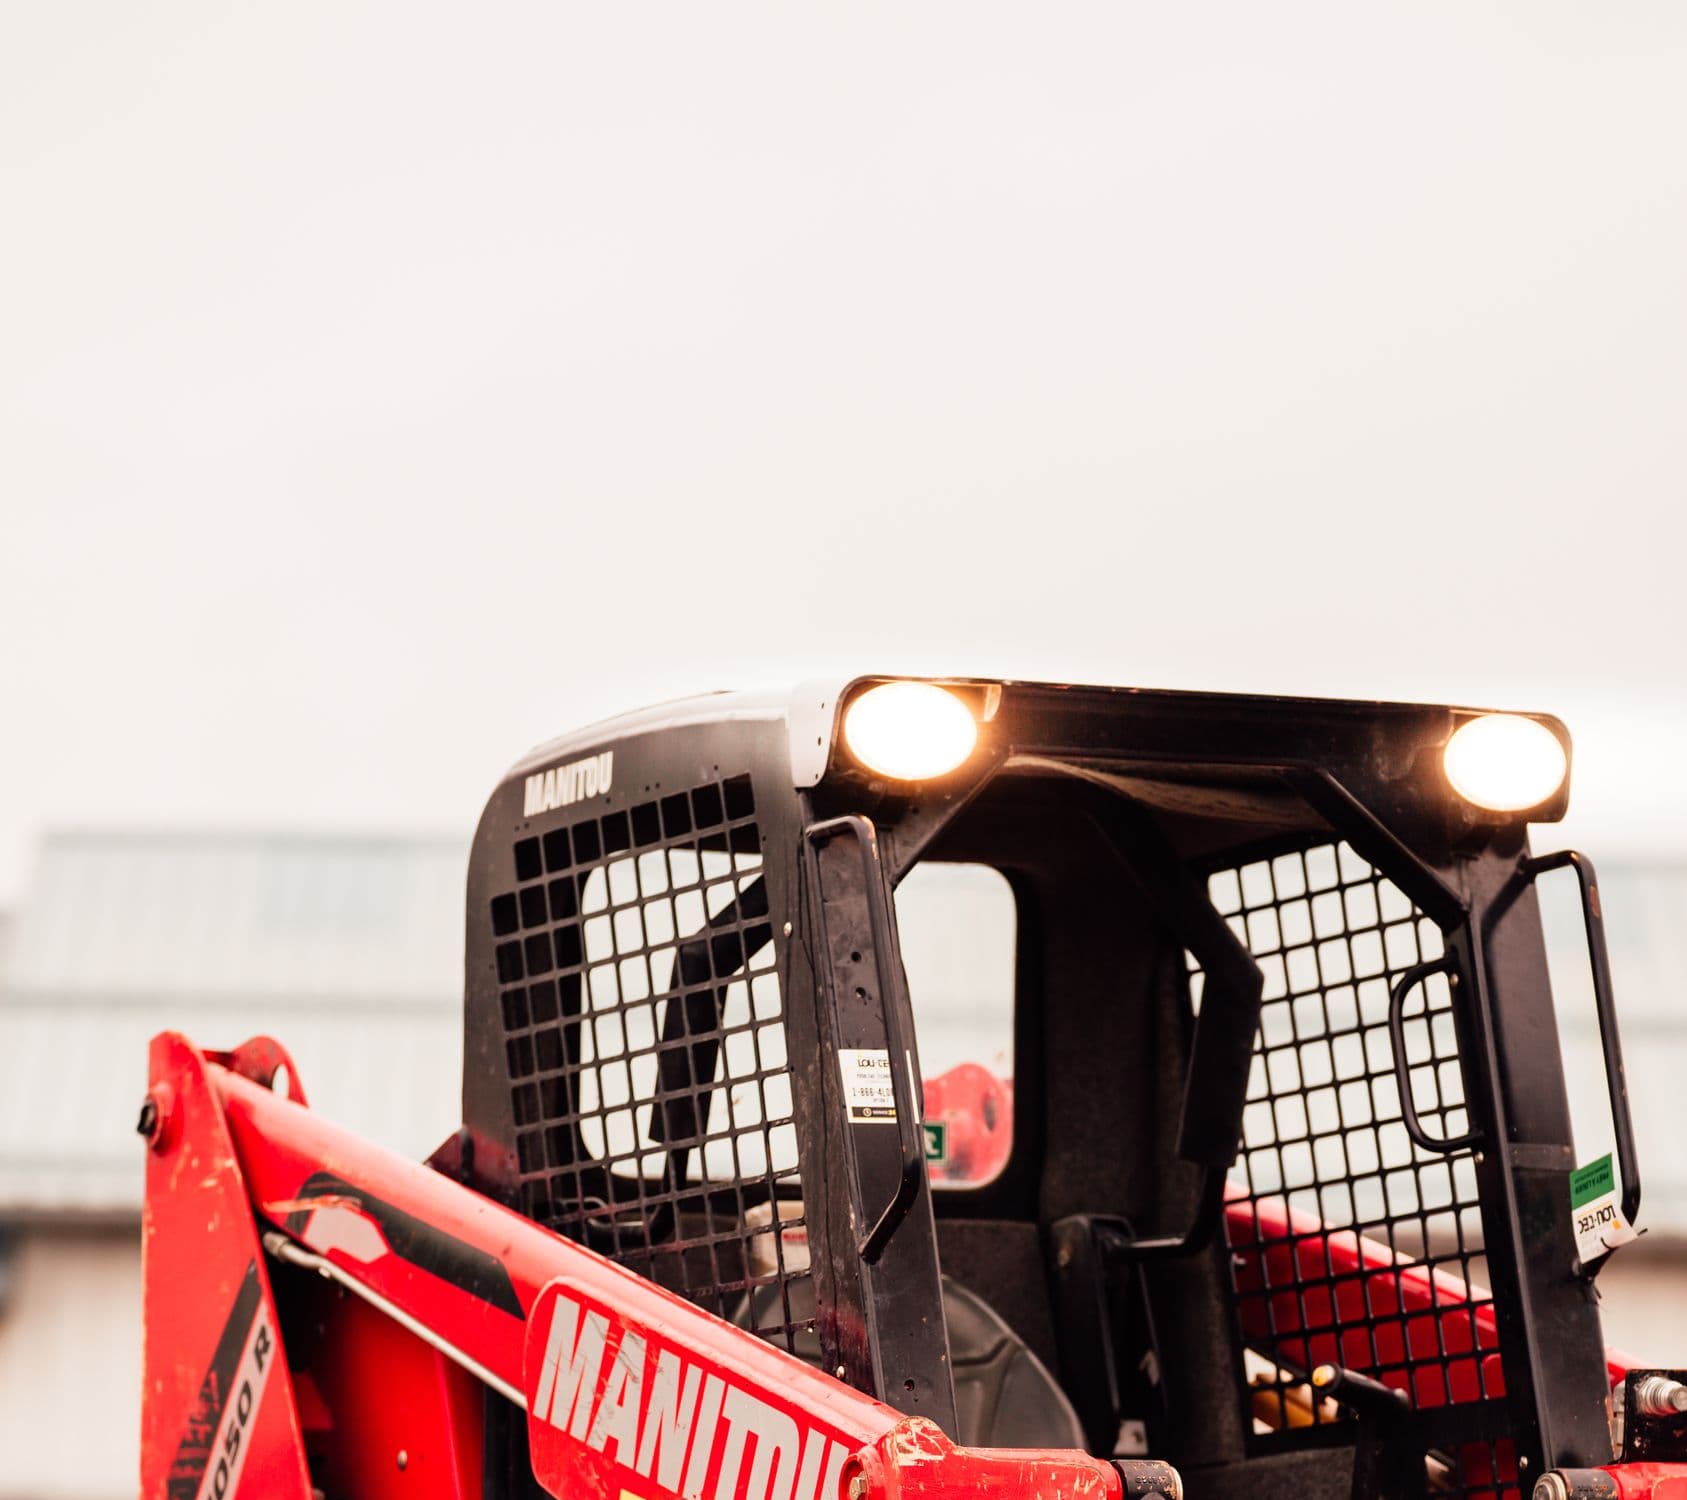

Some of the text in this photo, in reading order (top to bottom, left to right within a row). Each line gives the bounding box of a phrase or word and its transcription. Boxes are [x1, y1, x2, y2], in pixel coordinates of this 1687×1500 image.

[524, 751, 614, 818] MANITOU
[857, 1059, 890, 1068] LOU-TE
[254, 1325, 271, 1374] R
